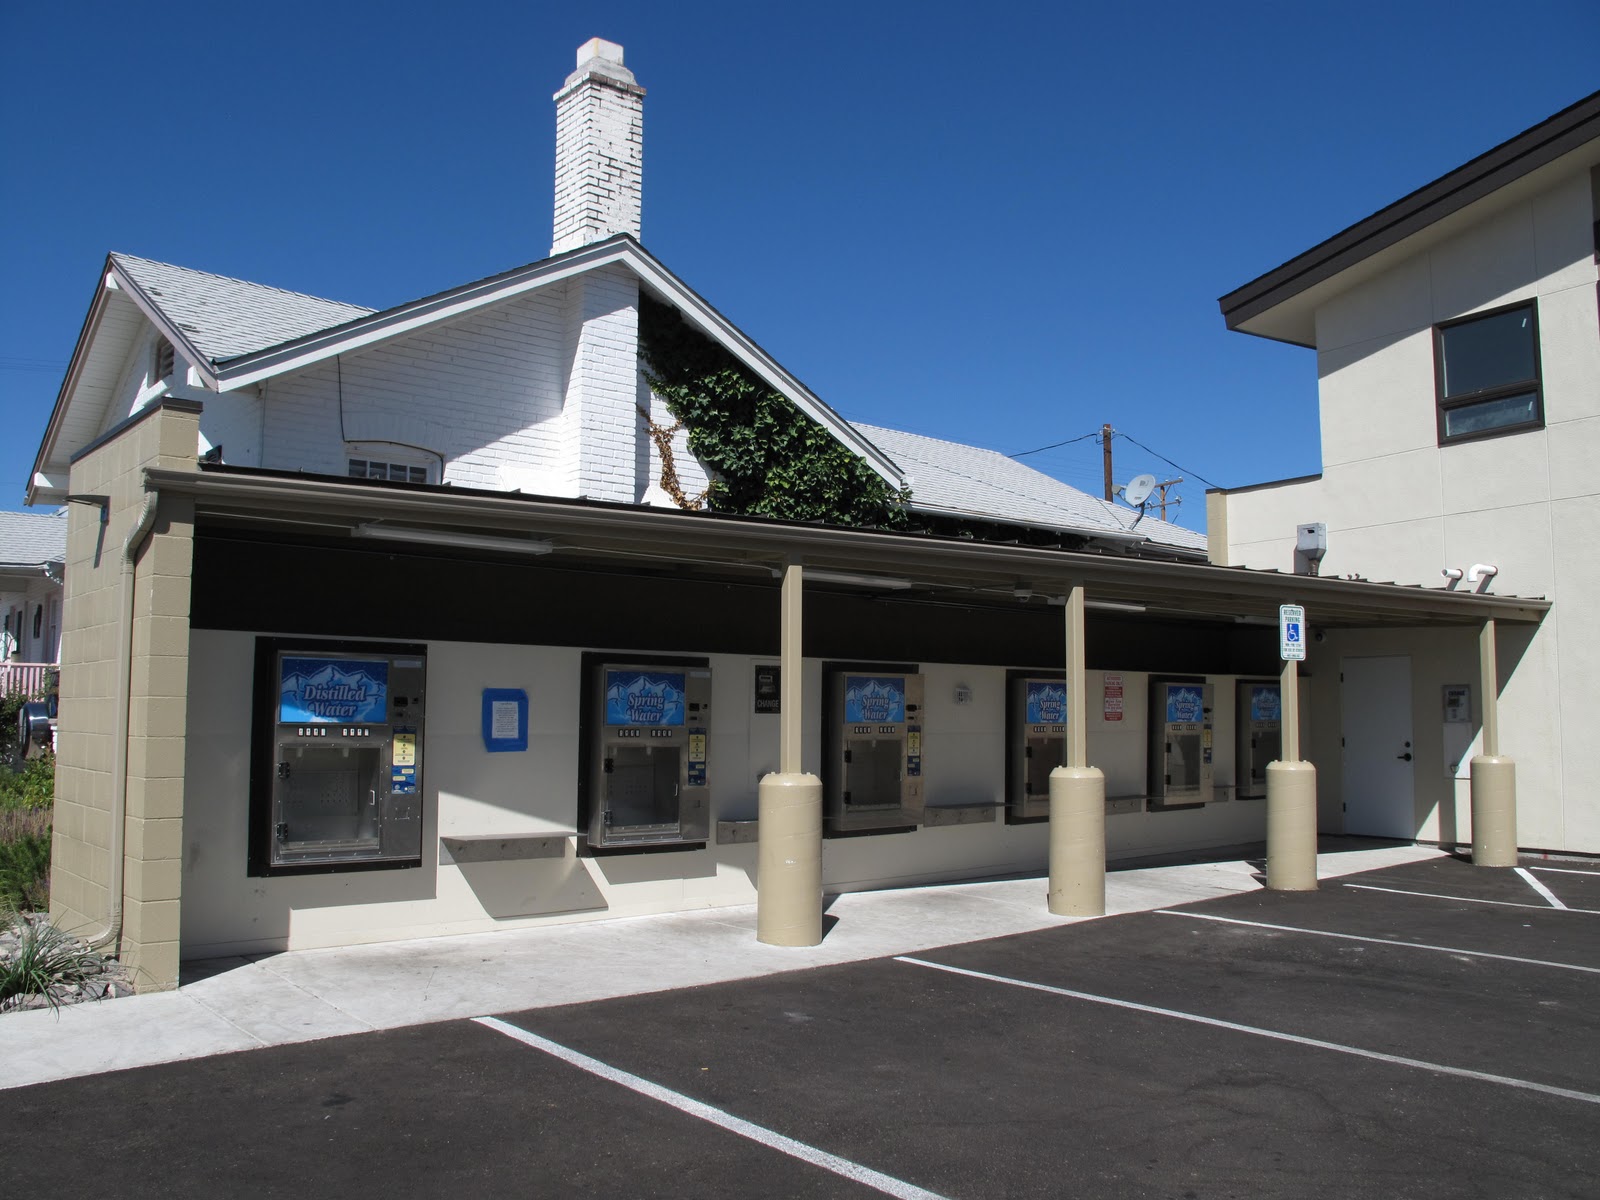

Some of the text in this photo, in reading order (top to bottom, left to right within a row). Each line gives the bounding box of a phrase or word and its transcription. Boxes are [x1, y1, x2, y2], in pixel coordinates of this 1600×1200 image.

[304, 685, 366, 701] Distilled
[628, 693, 665, 709] Spring
[757, 699, 779, 708] CHANGE
[862, 695, 890, 709] Spring
[1039, 699, 1061, 710] Spring
[1175, 701, 1195, 711] Spring
[311, 703, 356, 717] Water
[630, 709, 662, 722] Water
[864, 709, 888, 720] Water
[1039, 711, 1060, 720] Water
[1177, 711, 1193, 719] Water
